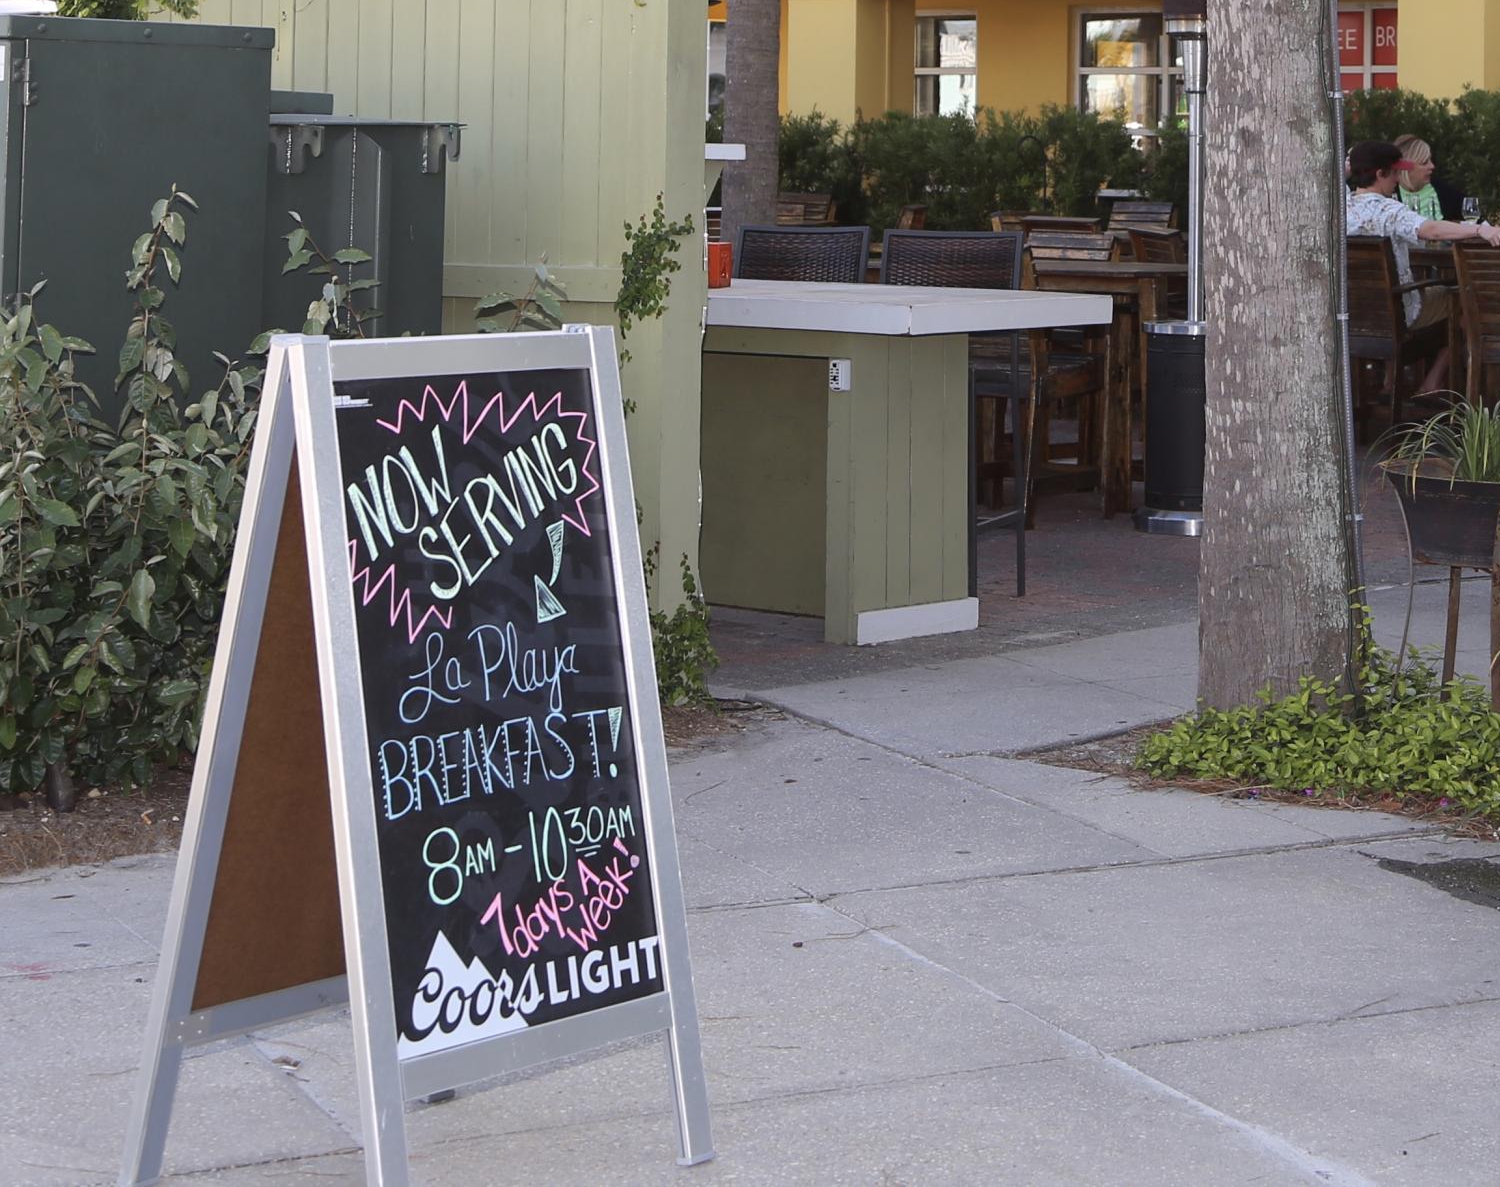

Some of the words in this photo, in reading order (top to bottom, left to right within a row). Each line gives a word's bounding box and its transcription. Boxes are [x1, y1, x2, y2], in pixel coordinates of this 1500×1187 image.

[346, 423, 452, 562] NOW
[418, 422, 578, 600] SERVING
[398, 632, 472, 723] La
[467, 621, 580, 714] Playa
[377, 706, 624, 821] BREAKFAST!
[401, 962, 545, 1043] Coors
[546, 935, 660, 1006] LIGHT
